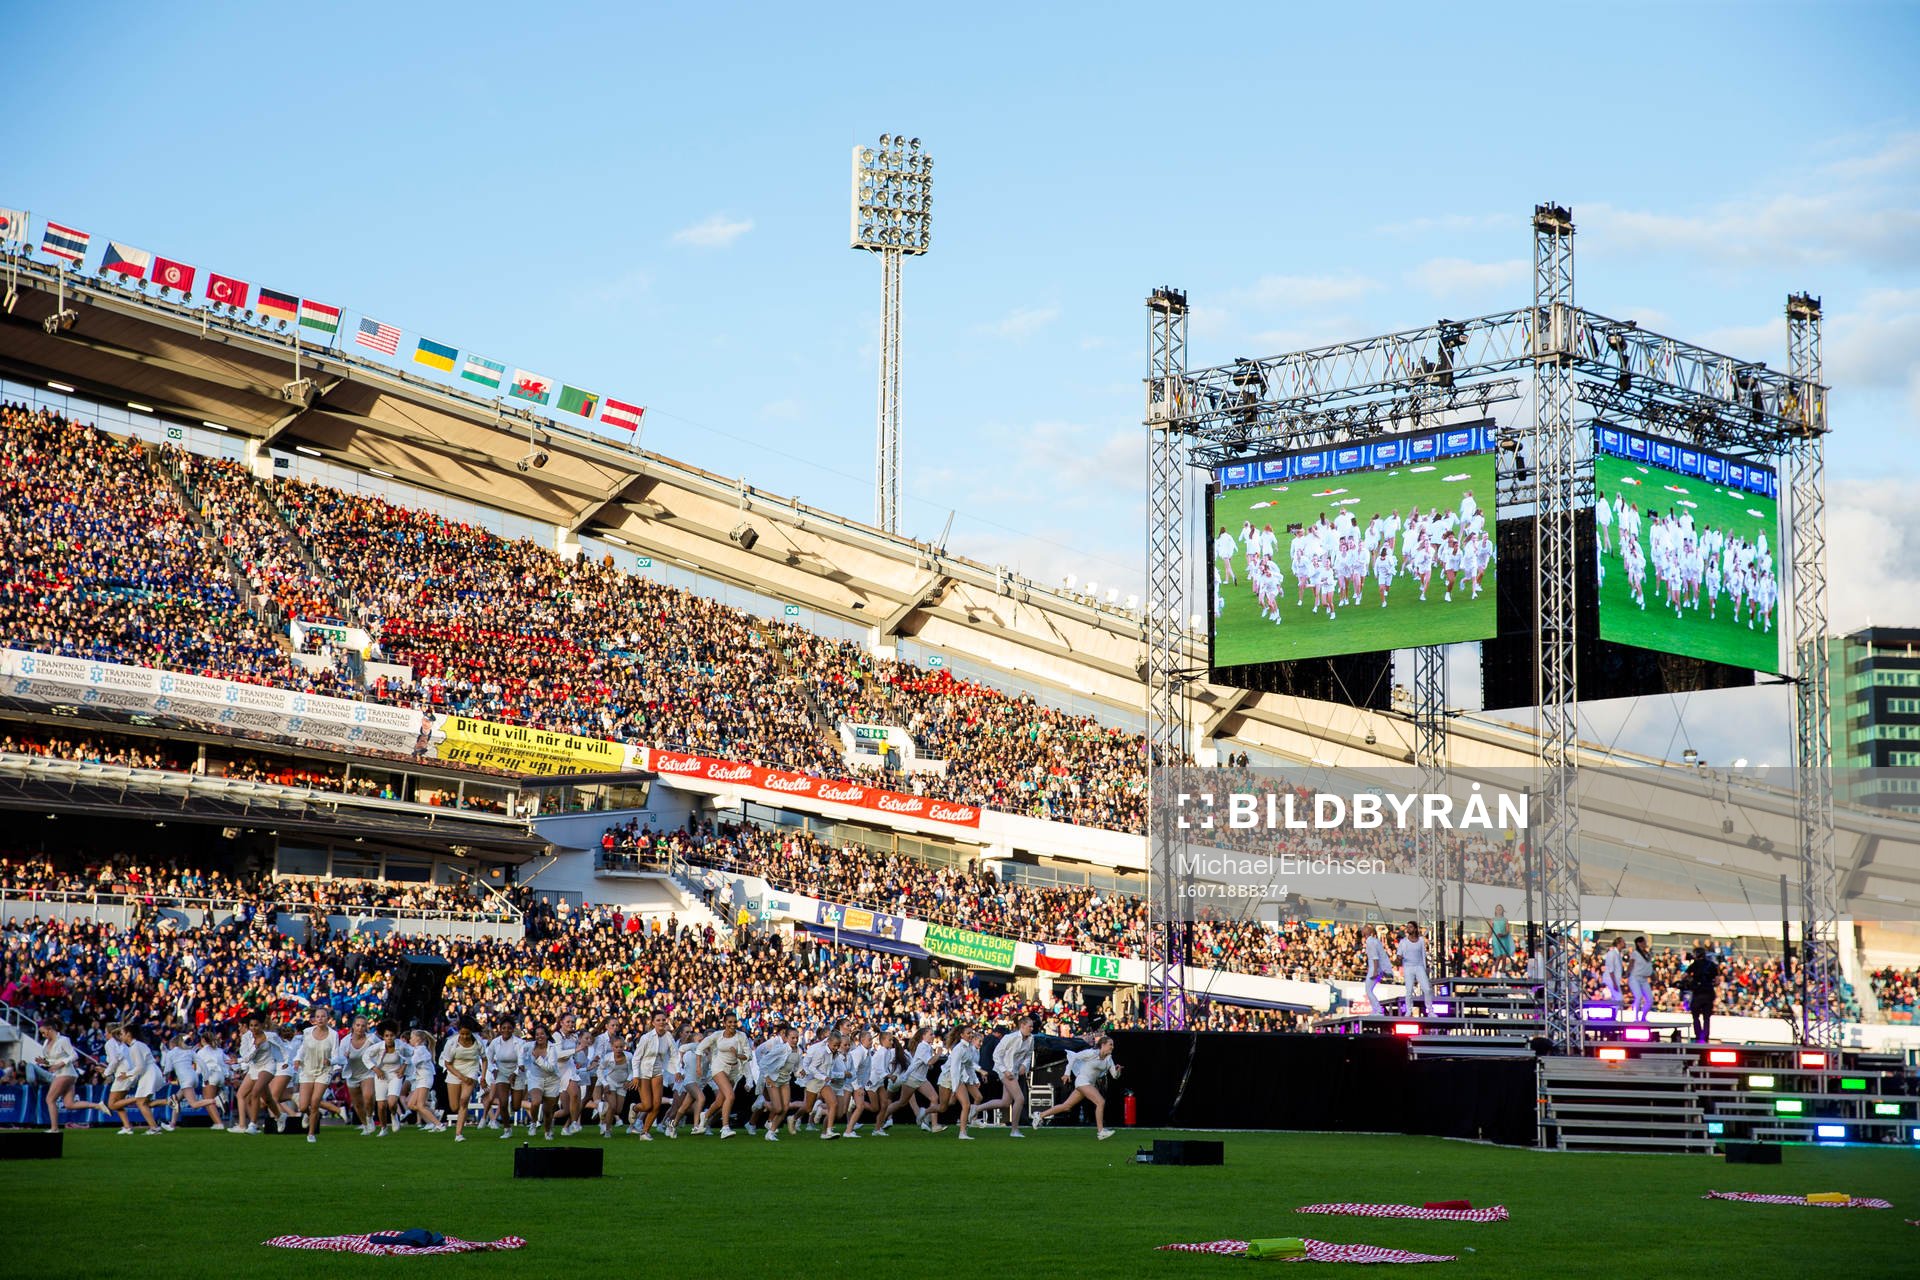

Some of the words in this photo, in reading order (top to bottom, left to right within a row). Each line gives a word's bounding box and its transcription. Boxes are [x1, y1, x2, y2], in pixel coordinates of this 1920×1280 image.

[36, 659, 86, 672] TRANPENAD
[36, 668, 85, 680] BEMANNING
[104, 668, 153, 681] TRANPENAD
[104, 676, 152, 689] BEMANNING
[175, 678, 222, 691] TRANPENAD
[175, 686, 221, 700] BEMANNING
[240, 689, 286, 701] TRANPENAD
[240, 697, 285, 710] BEMANNING
[307, 699, 351, 712] TRANPENAD
[307, 707, 351, 720] BEMANNING
[368, 708, 410, 721] TRANPENAD
[367, 716, 410, 728] BEMANNING
[457, 719, 477, 733] Dit
[483, 724, 500, 736] du
[506, 728, 531, 743] vill,
[537, 733, 561, 746] när
[565, 738, 582, 750] du
[587, 742, 612, 755] vill.
[657, 755, 702, 772] Estrella
[707, 763, 752, 780] Estrella
[765, 774, 811, 791] Estrella
[818, 784, 863, 801] Estrella
[878, 796, 923, 812] Estrella
[929, 805, 975, 821] Estrella
[929, 924, 957, 940] TACK
